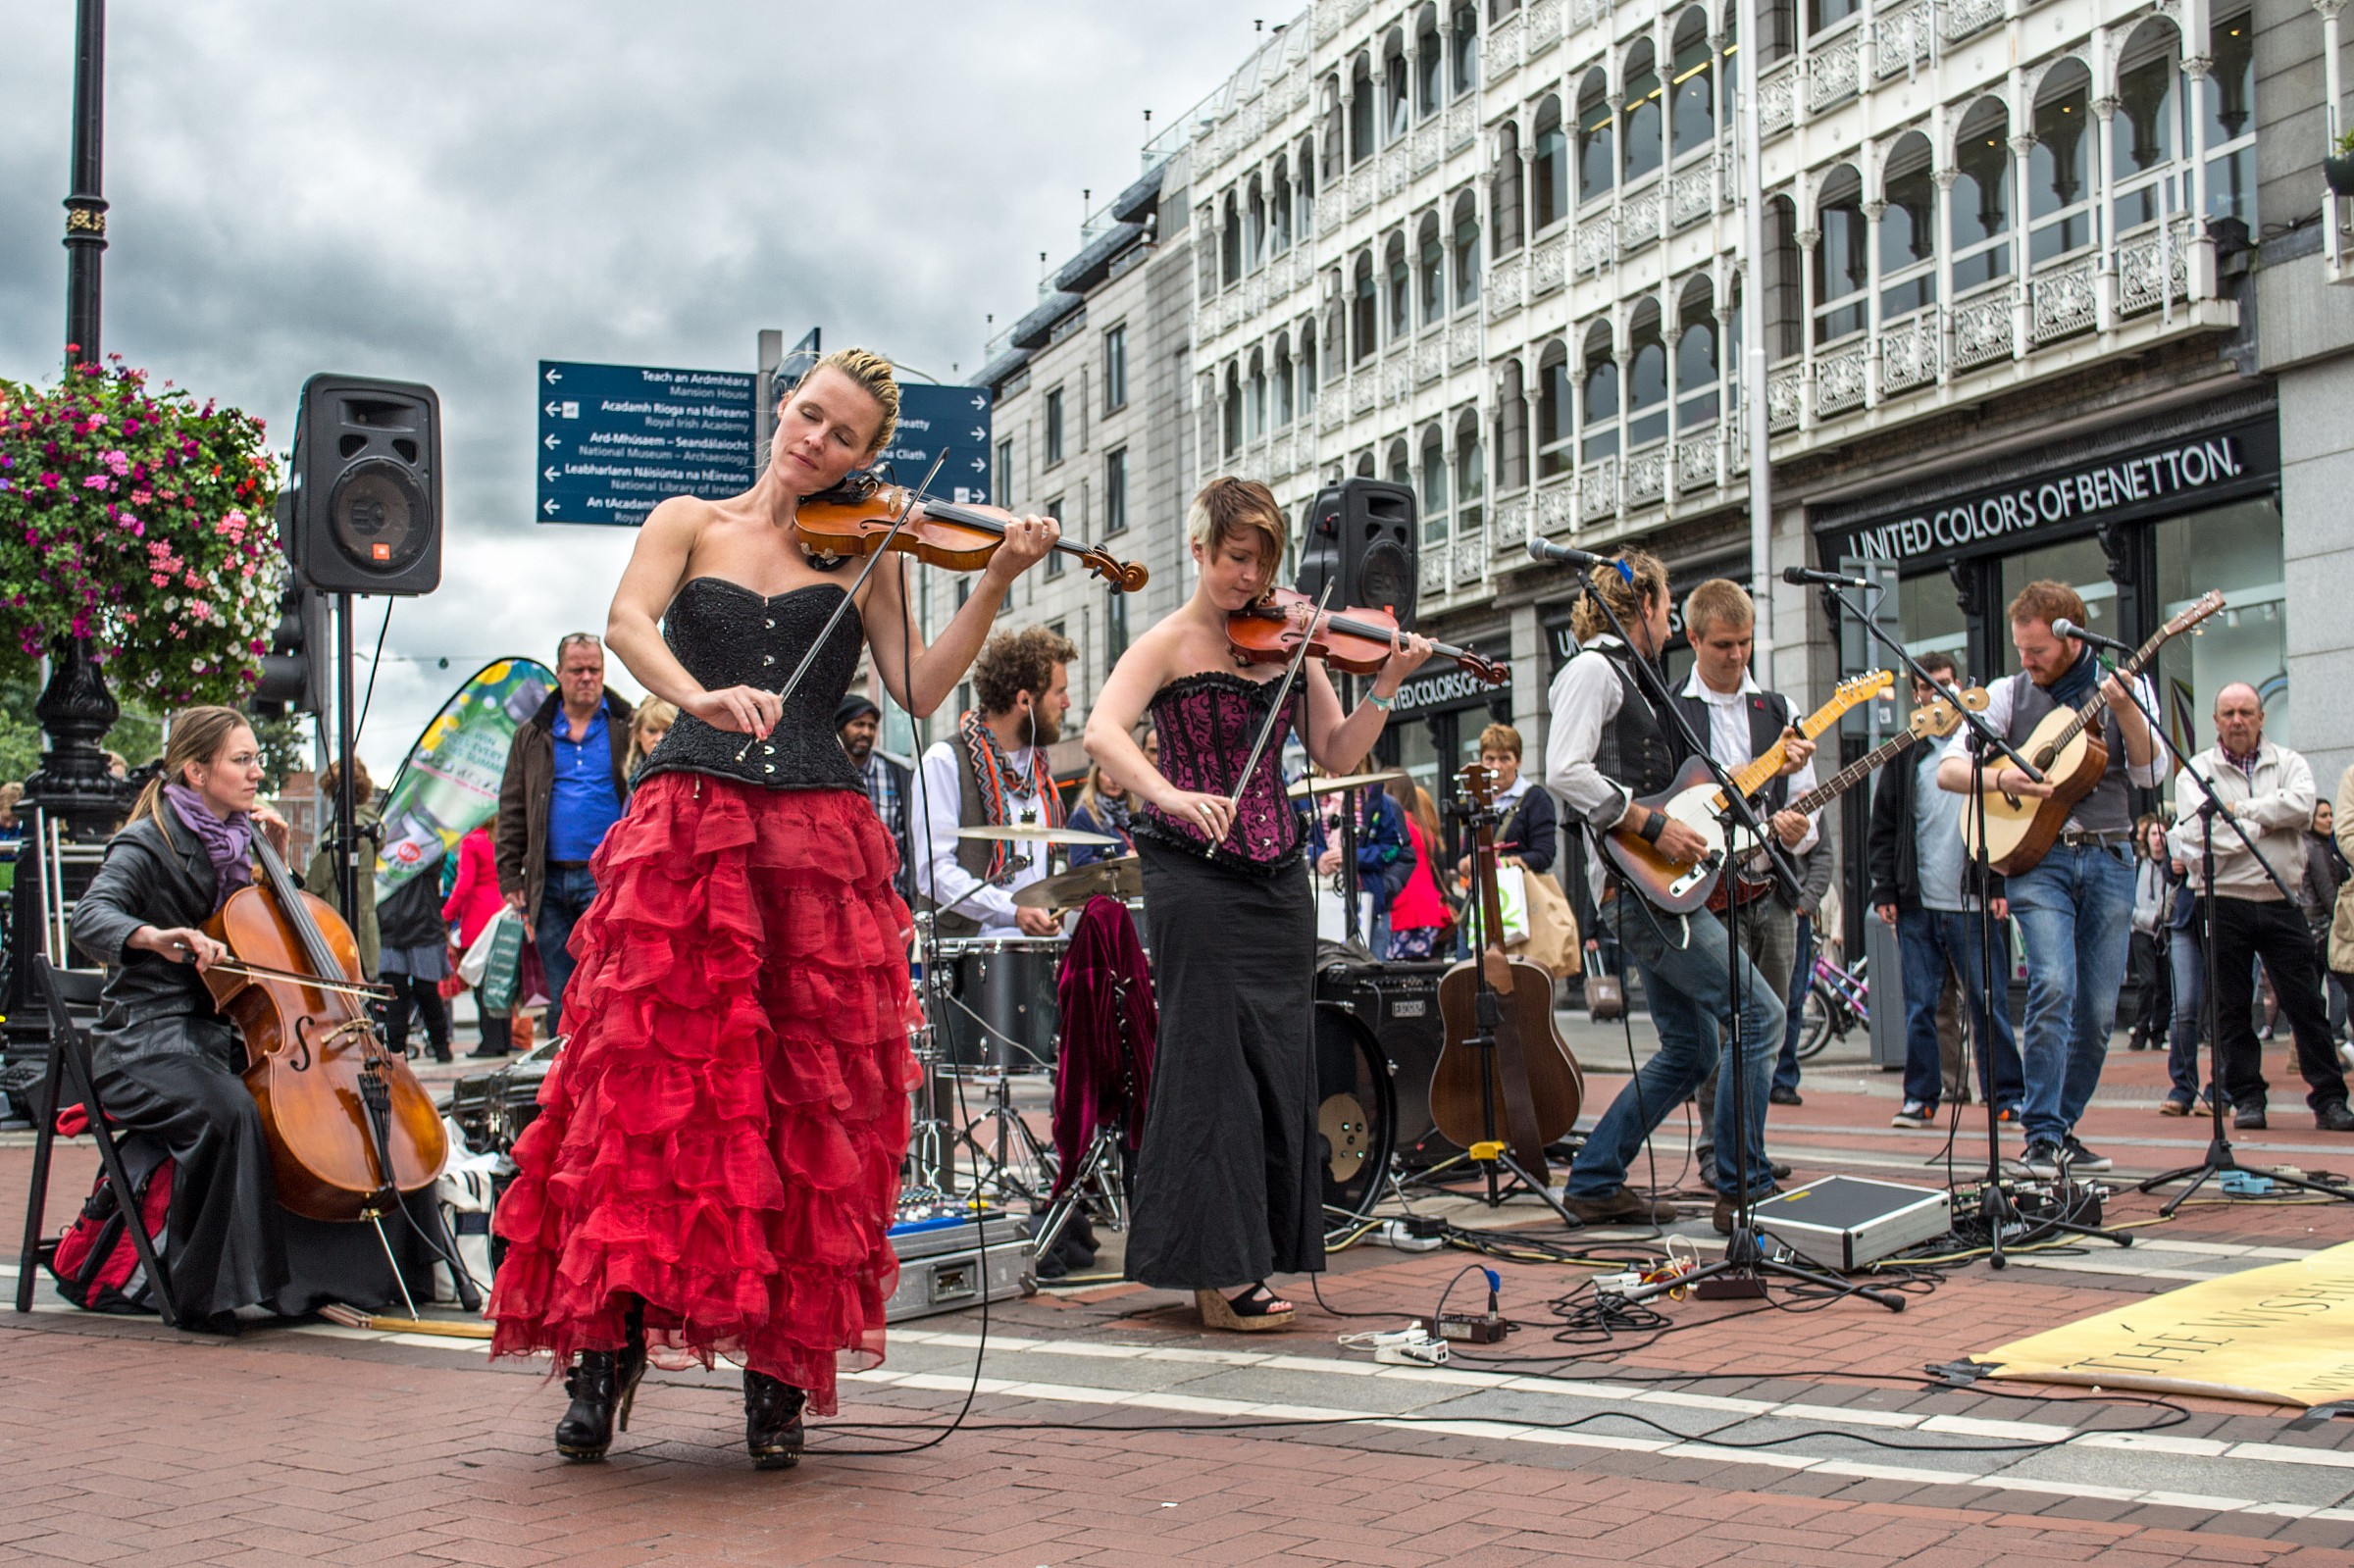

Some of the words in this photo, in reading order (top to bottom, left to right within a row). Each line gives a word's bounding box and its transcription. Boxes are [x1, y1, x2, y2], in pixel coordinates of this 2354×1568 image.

[642, 370, 672, 382] Teach
[674, 375, 688, 383] an
[670, 386, 714, 398] Mansion
[718, 389, 749, 401] House
[601, 400, 651, 414] Acadamh
[687, 406, 700, 416] na
[645, 416, 675, 430] Royal
[677, 417, 699, 430] Irish
[701, 419, 749, 433] Academy
[579, 445, 625, 458] National
[627, 447, 673, 460] Museum
[683, 452, 749, 467] Archaeology
[896, 449, 926, 460] Cliath
[565, 463, 632, 477] Leabharlann
[687, 470, 700, 480] na
[611, 479, 656, 491] National
[659, 481, 695, 494] Library
[697, 482, 709, 493] of
[587, 496, 603, 507] An
[614, 512, 644, 526] Royal
[1849, 518, 1932, 560] UNITED
[1933, 490, 2036, 547] COLORS
[2037, 480, 2076, 522] OF
[1414, 672, 1460, 706] COLORS
[2062, 1334, 2235, 1374] THE
